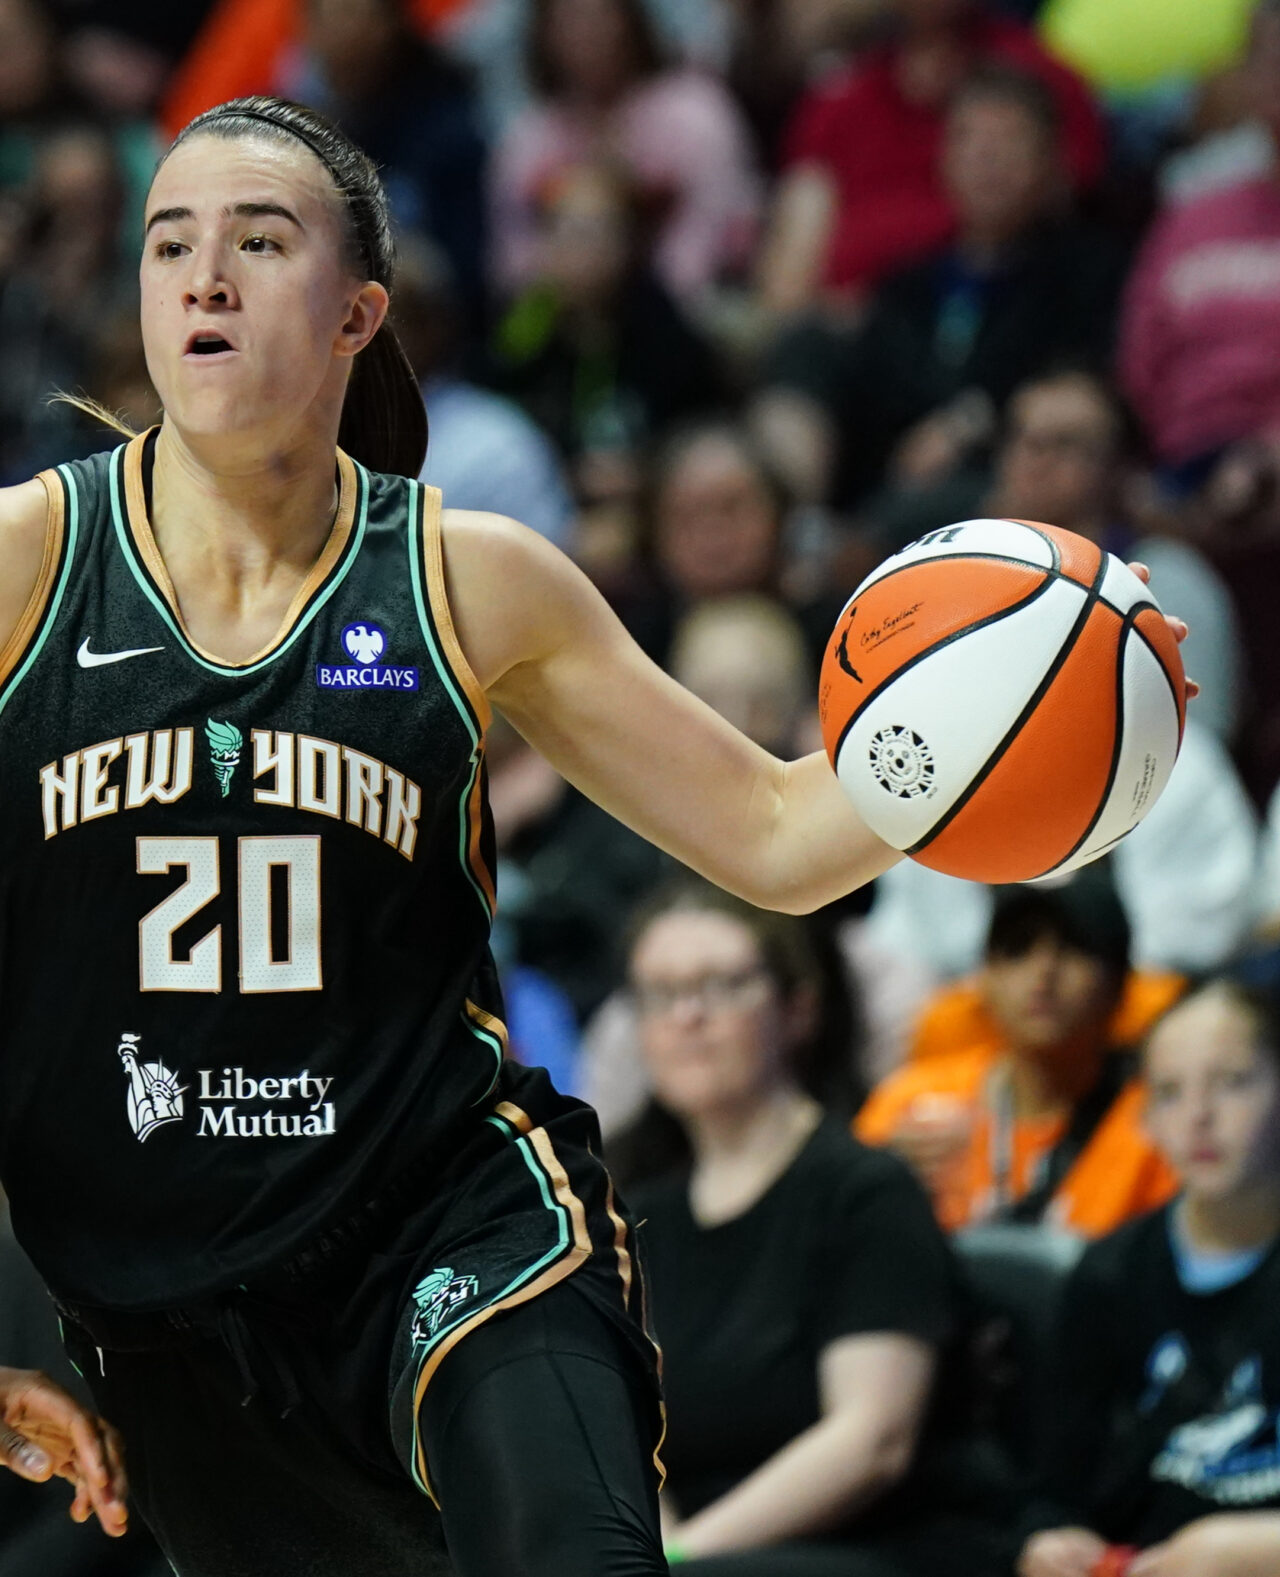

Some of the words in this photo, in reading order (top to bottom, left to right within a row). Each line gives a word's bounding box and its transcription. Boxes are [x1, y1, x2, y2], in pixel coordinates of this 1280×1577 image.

[320, 667, 415, 689] BARCLAYS
[39, 726, 195, 841] NEW
[249, 728, 422, 862] YORK
[135, 834, 324, 995] 20
[197, 1067, 335, 1111] Liberty
[196, 1102, 336, 1137] Mutual
